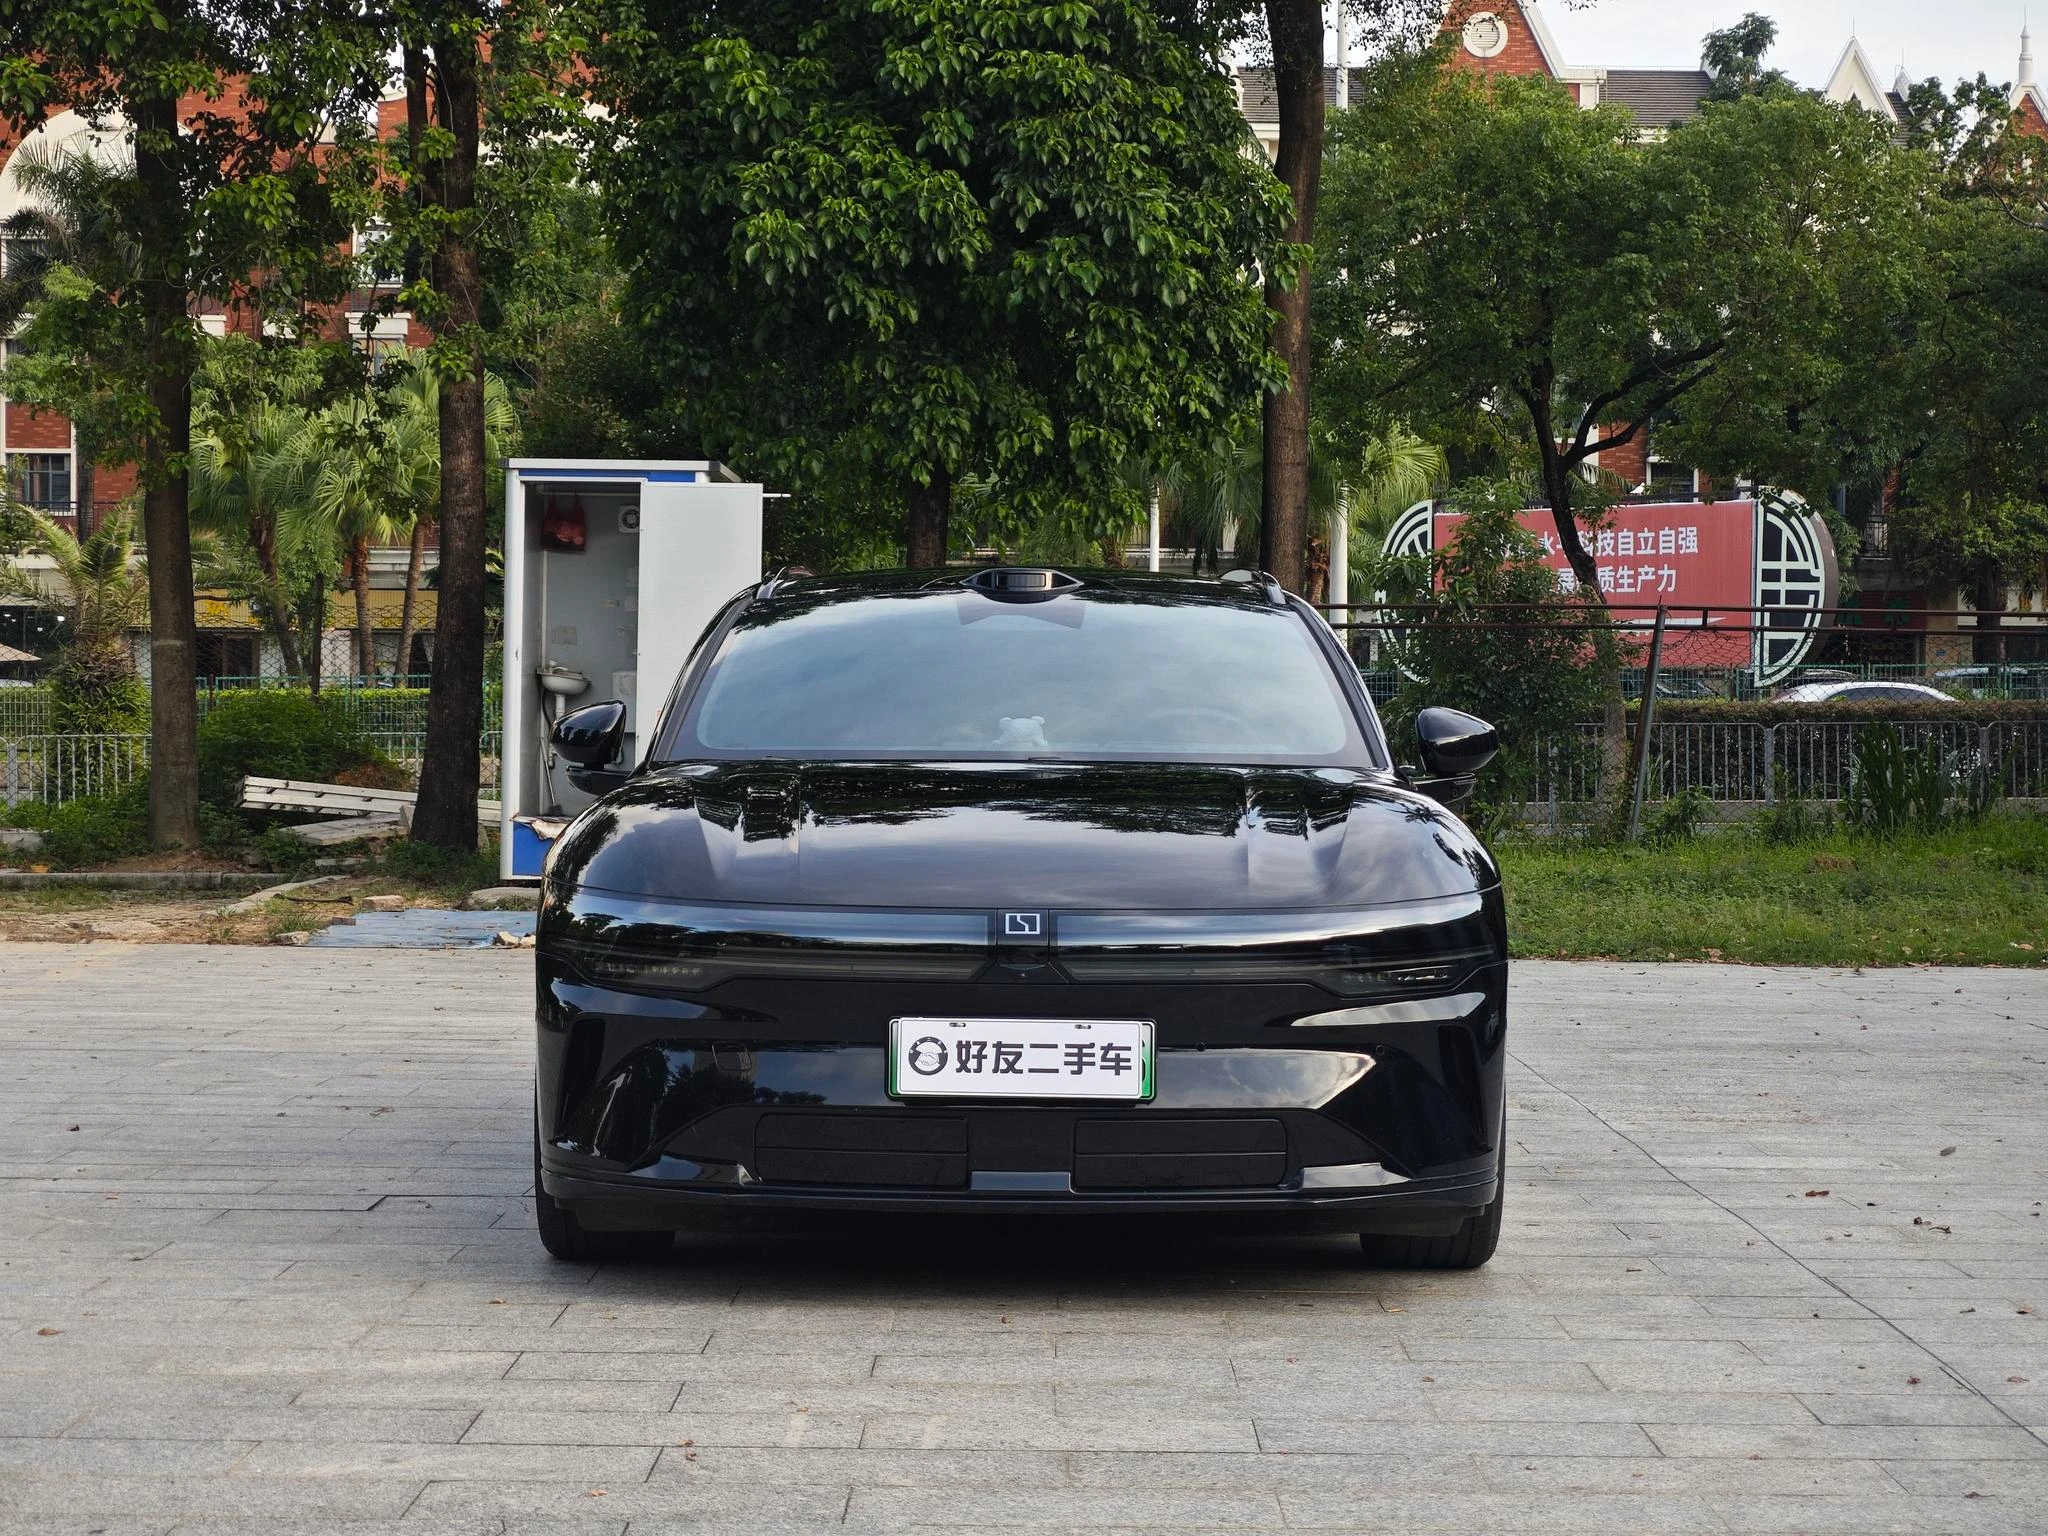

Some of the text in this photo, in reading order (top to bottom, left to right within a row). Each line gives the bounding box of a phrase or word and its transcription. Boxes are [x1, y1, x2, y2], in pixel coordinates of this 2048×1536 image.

[1498, 526, 1699, 559] 水科技自立自强
[955, 1040, 1132, 1076] 好友二手车
